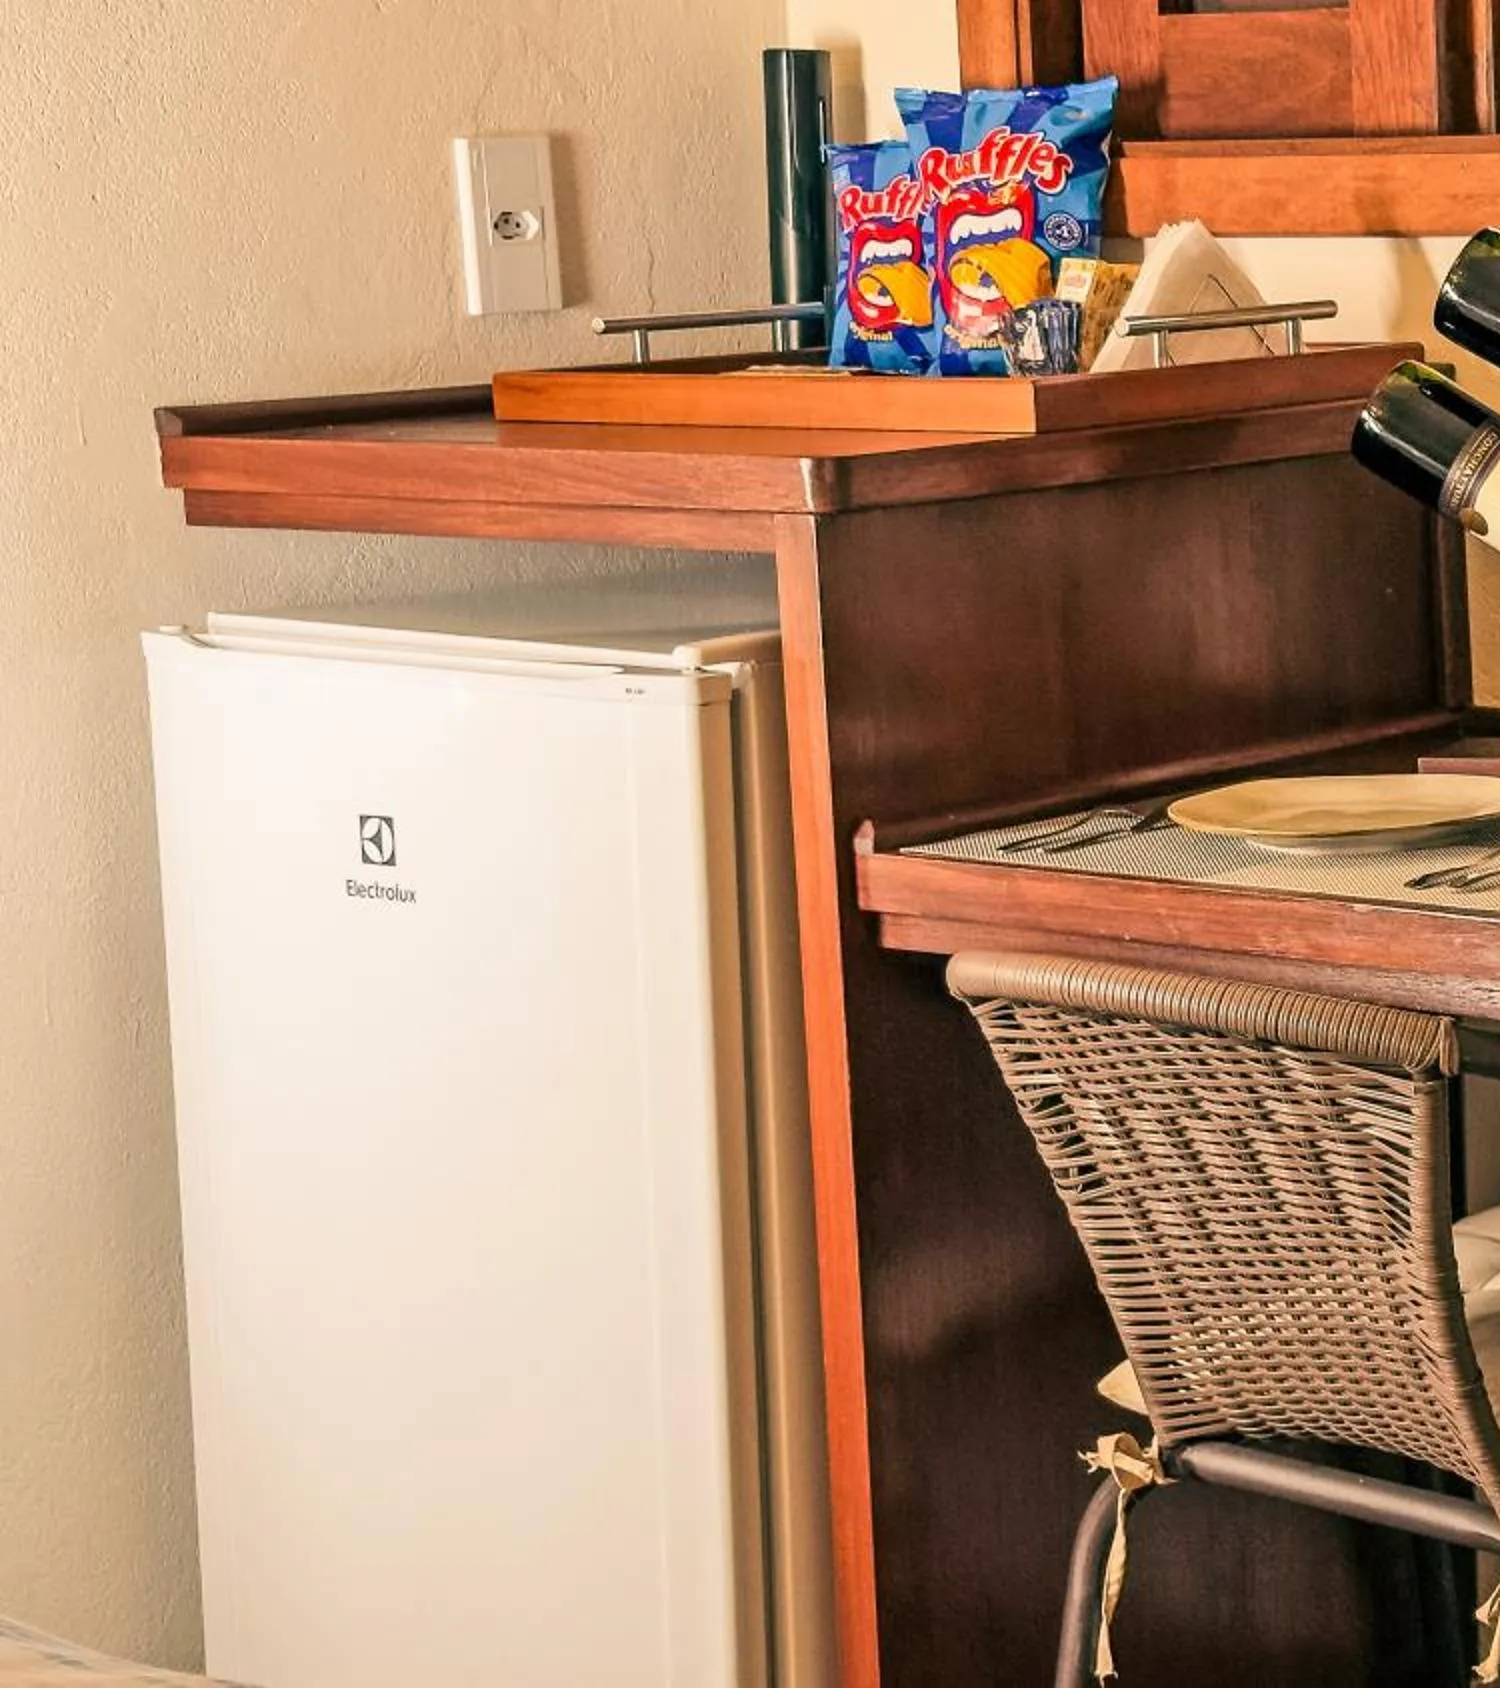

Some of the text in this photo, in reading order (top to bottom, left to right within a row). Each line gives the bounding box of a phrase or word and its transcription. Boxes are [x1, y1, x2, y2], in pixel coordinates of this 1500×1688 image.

[918, 126, 1074, 206] Ruffles
[839, 172, 933, 233] Ruffl
[345, 879, 417, 904] Electrolux
